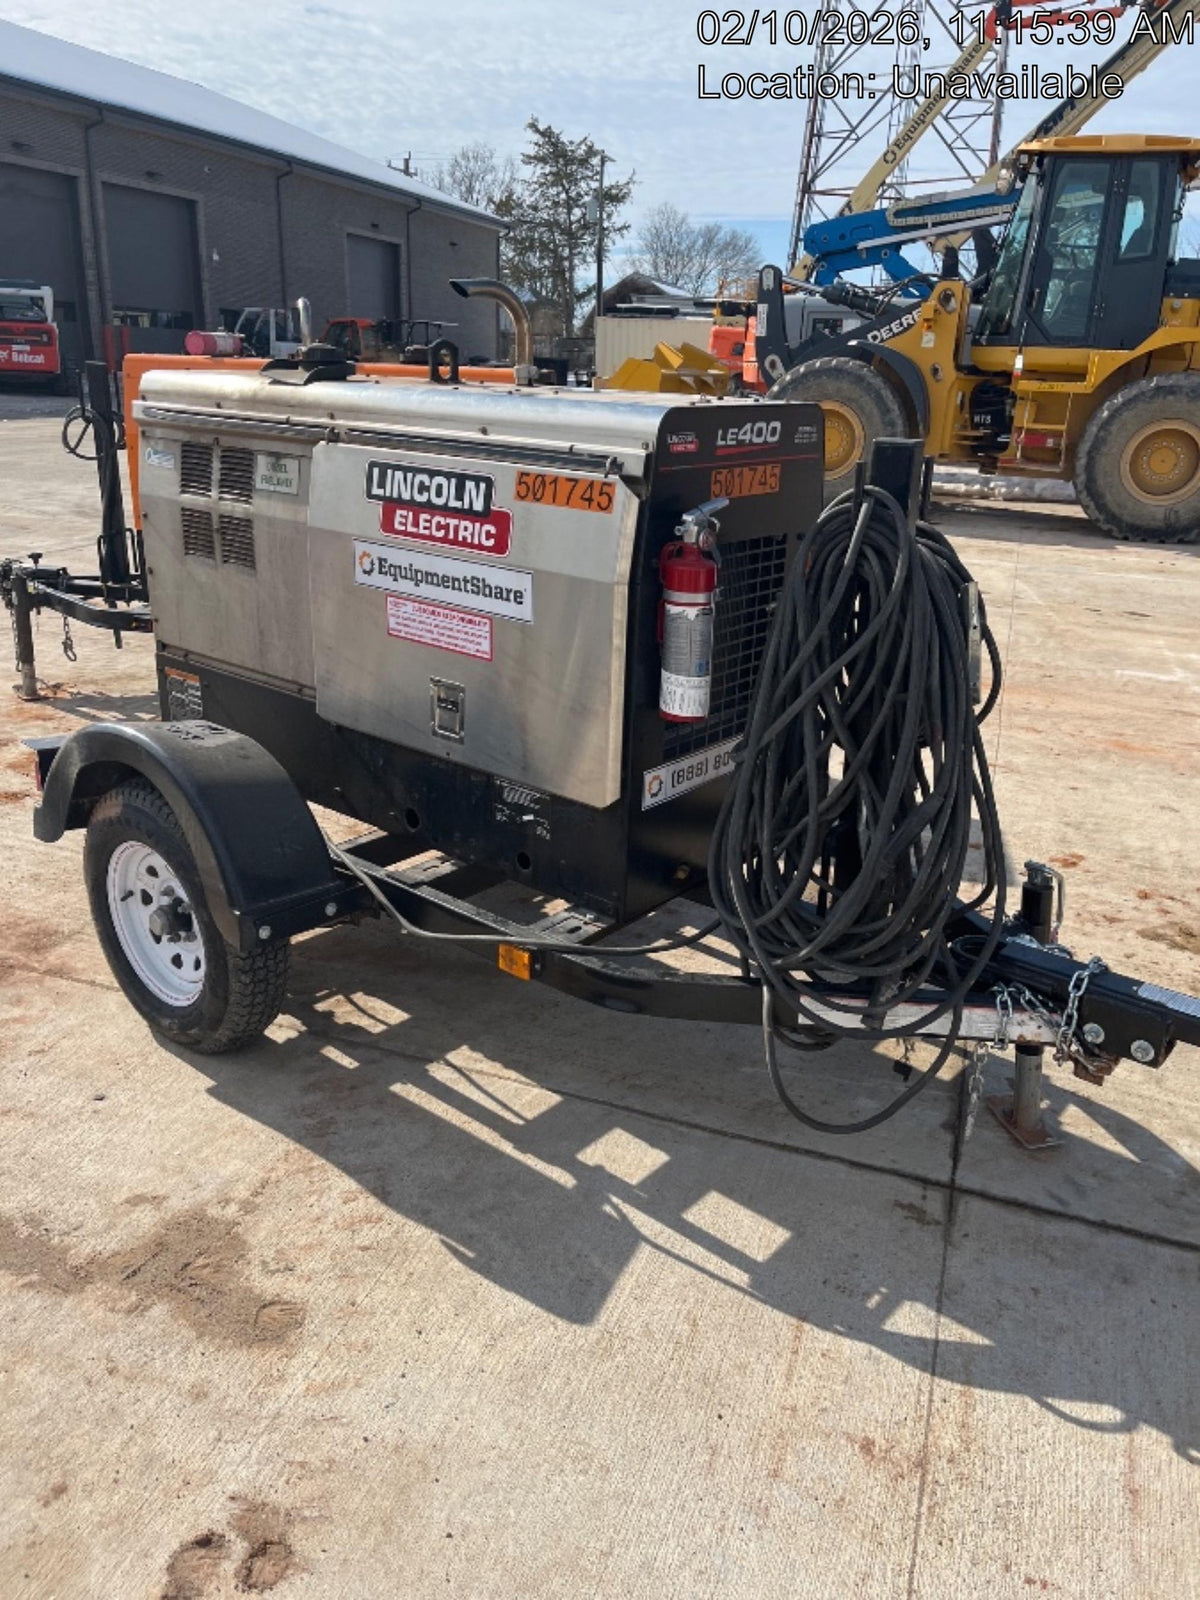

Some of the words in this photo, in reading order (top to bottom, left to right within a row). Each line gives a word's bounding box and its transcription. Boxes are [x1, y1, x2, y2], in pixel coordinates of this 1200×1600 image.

[716, 421, 781, 446] LE400
[371, 466, 487, 512] LINCOLN
[516, 472, 613, 511] 501745
[712, 463, 781, 498] 501745
[393, 509, 496, 547] ELECTRIC
[377, 556, 523, 605] EquipmentShare
[671, 757, 709, 788] (888)
